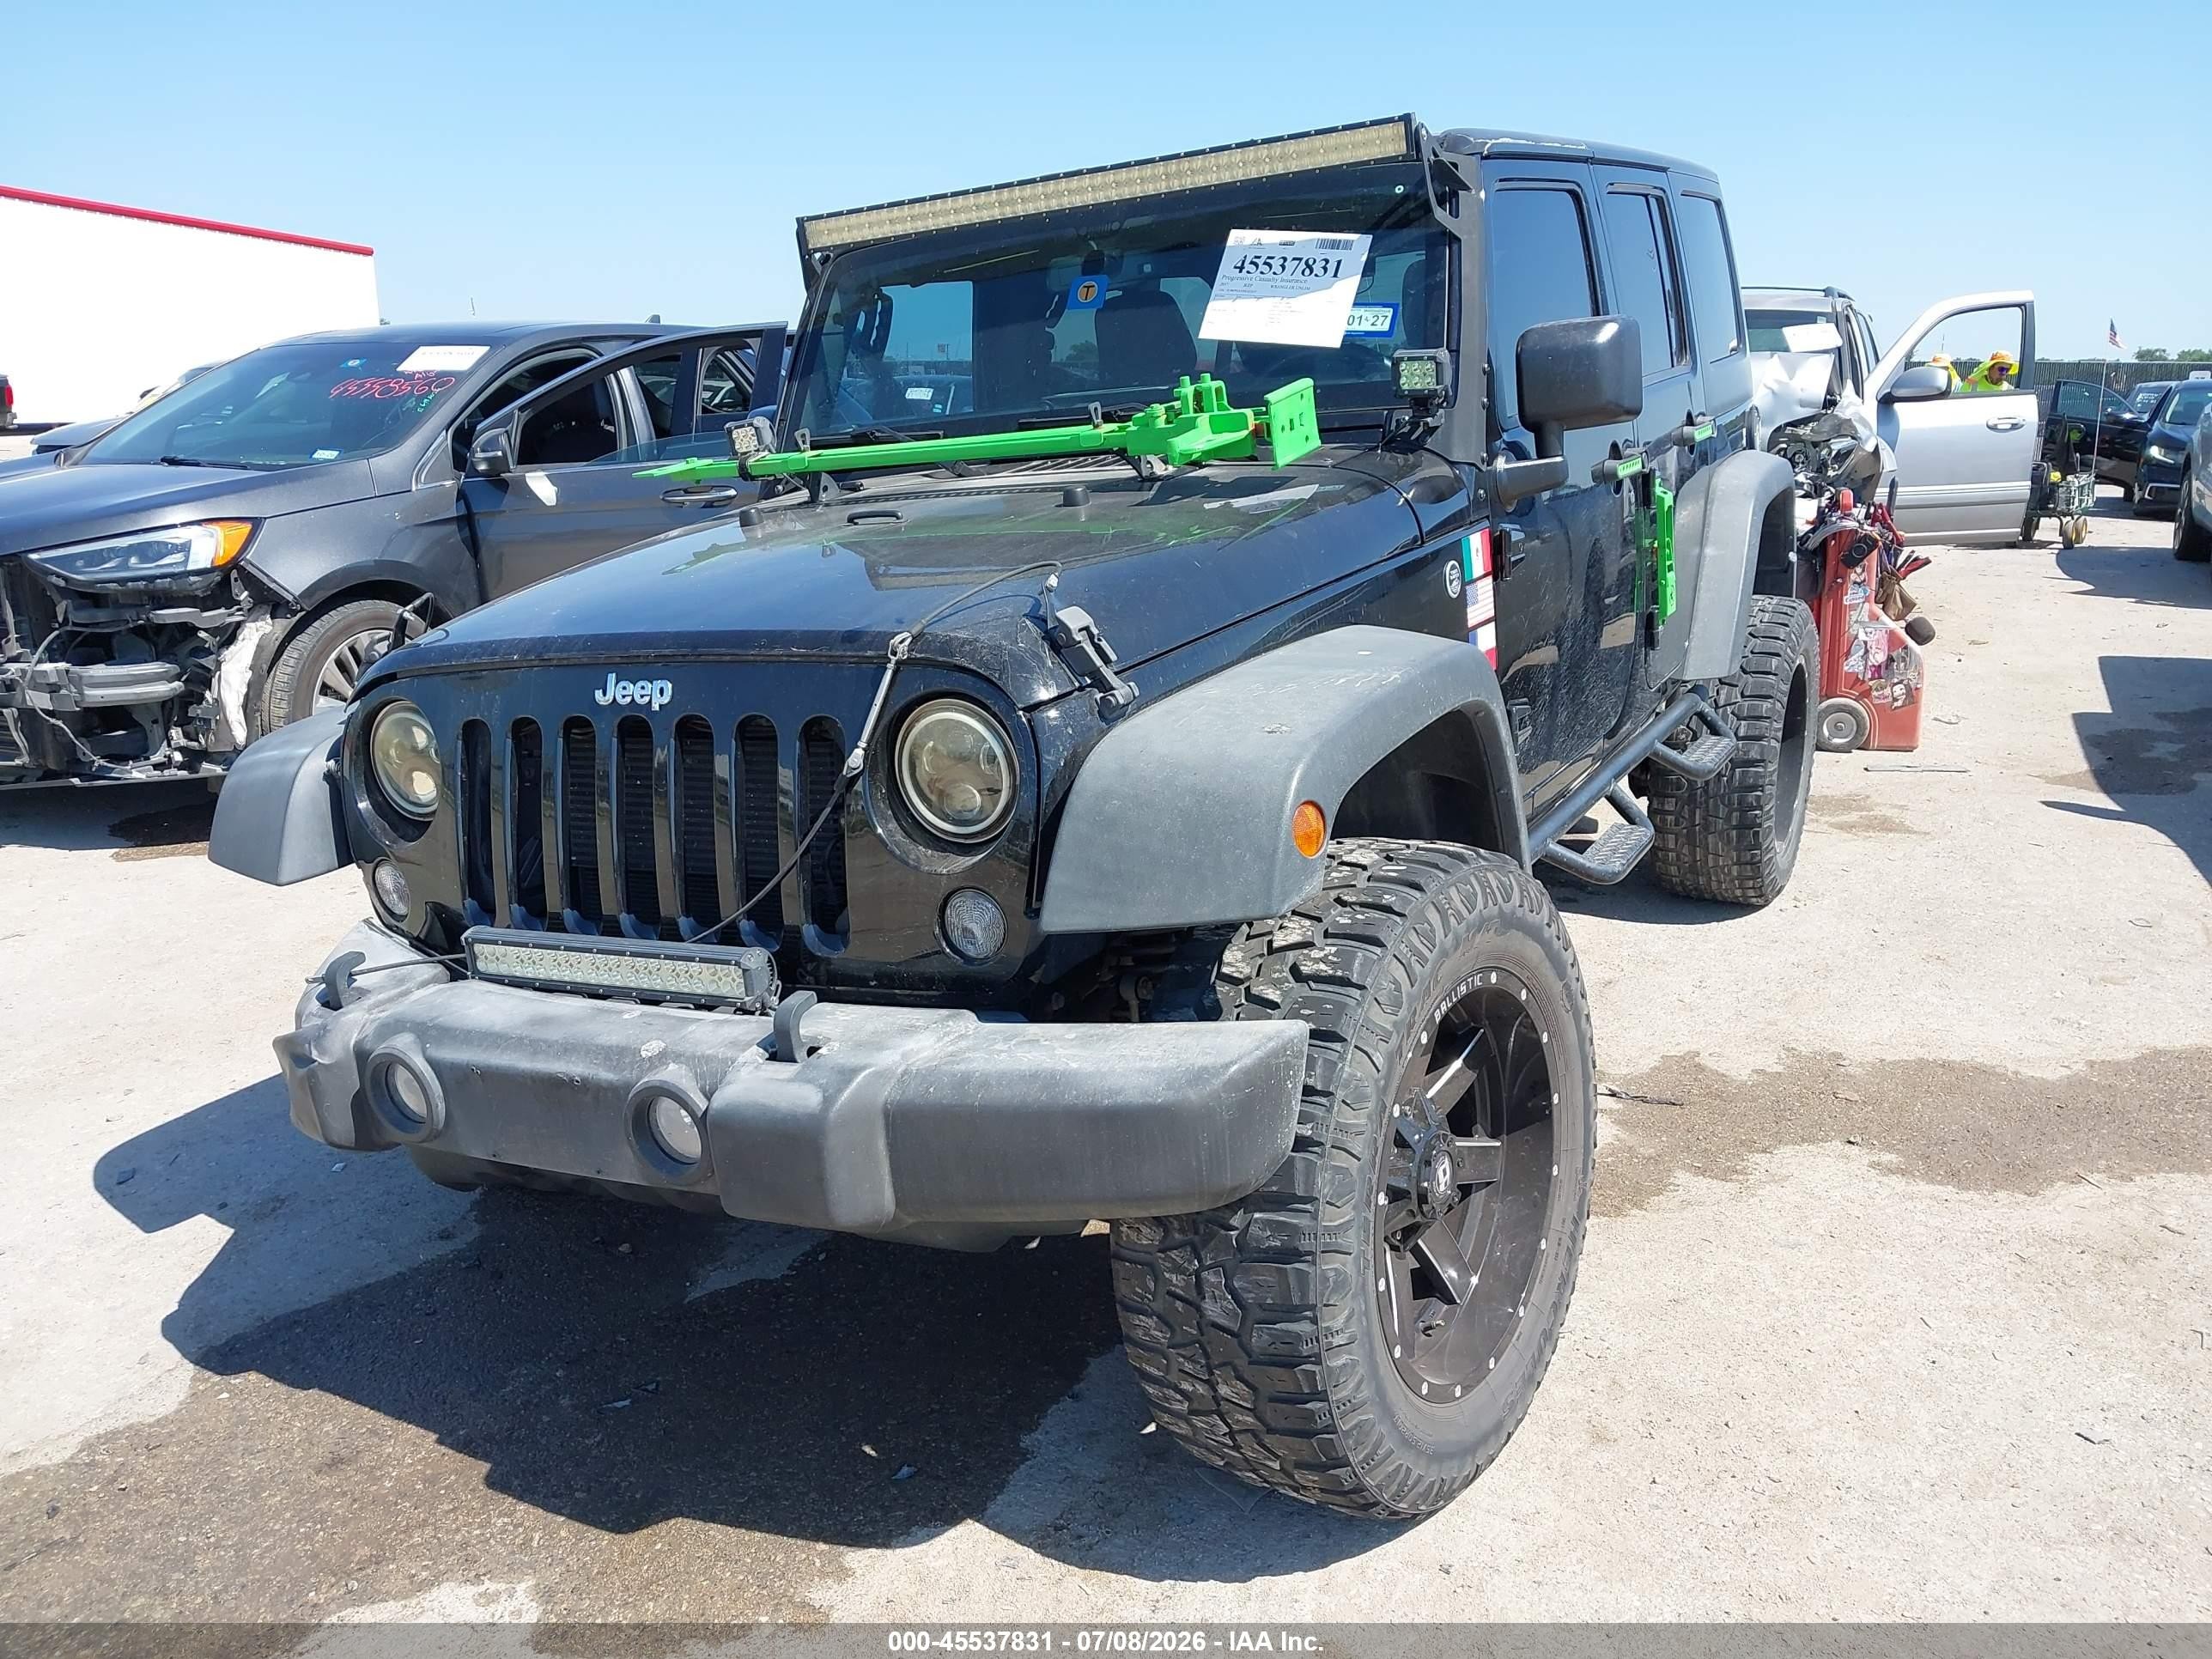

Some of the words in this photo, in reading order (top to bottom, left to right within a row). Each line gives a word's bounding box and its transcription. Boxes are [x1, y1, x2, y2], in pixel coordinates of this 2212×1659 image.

[1232, 254, 1342, 278] 45537831
[1221, 274, 1253, 283] Progressive
[1255, 275, 1279, 283] Casualty
[1346, 314, 1363, 326] 01
[1370, 314, 1389, 326] 27
[594, 672, 673, 711] Jeep
[1434, 973, 1483, 1024] BALLISTIC
